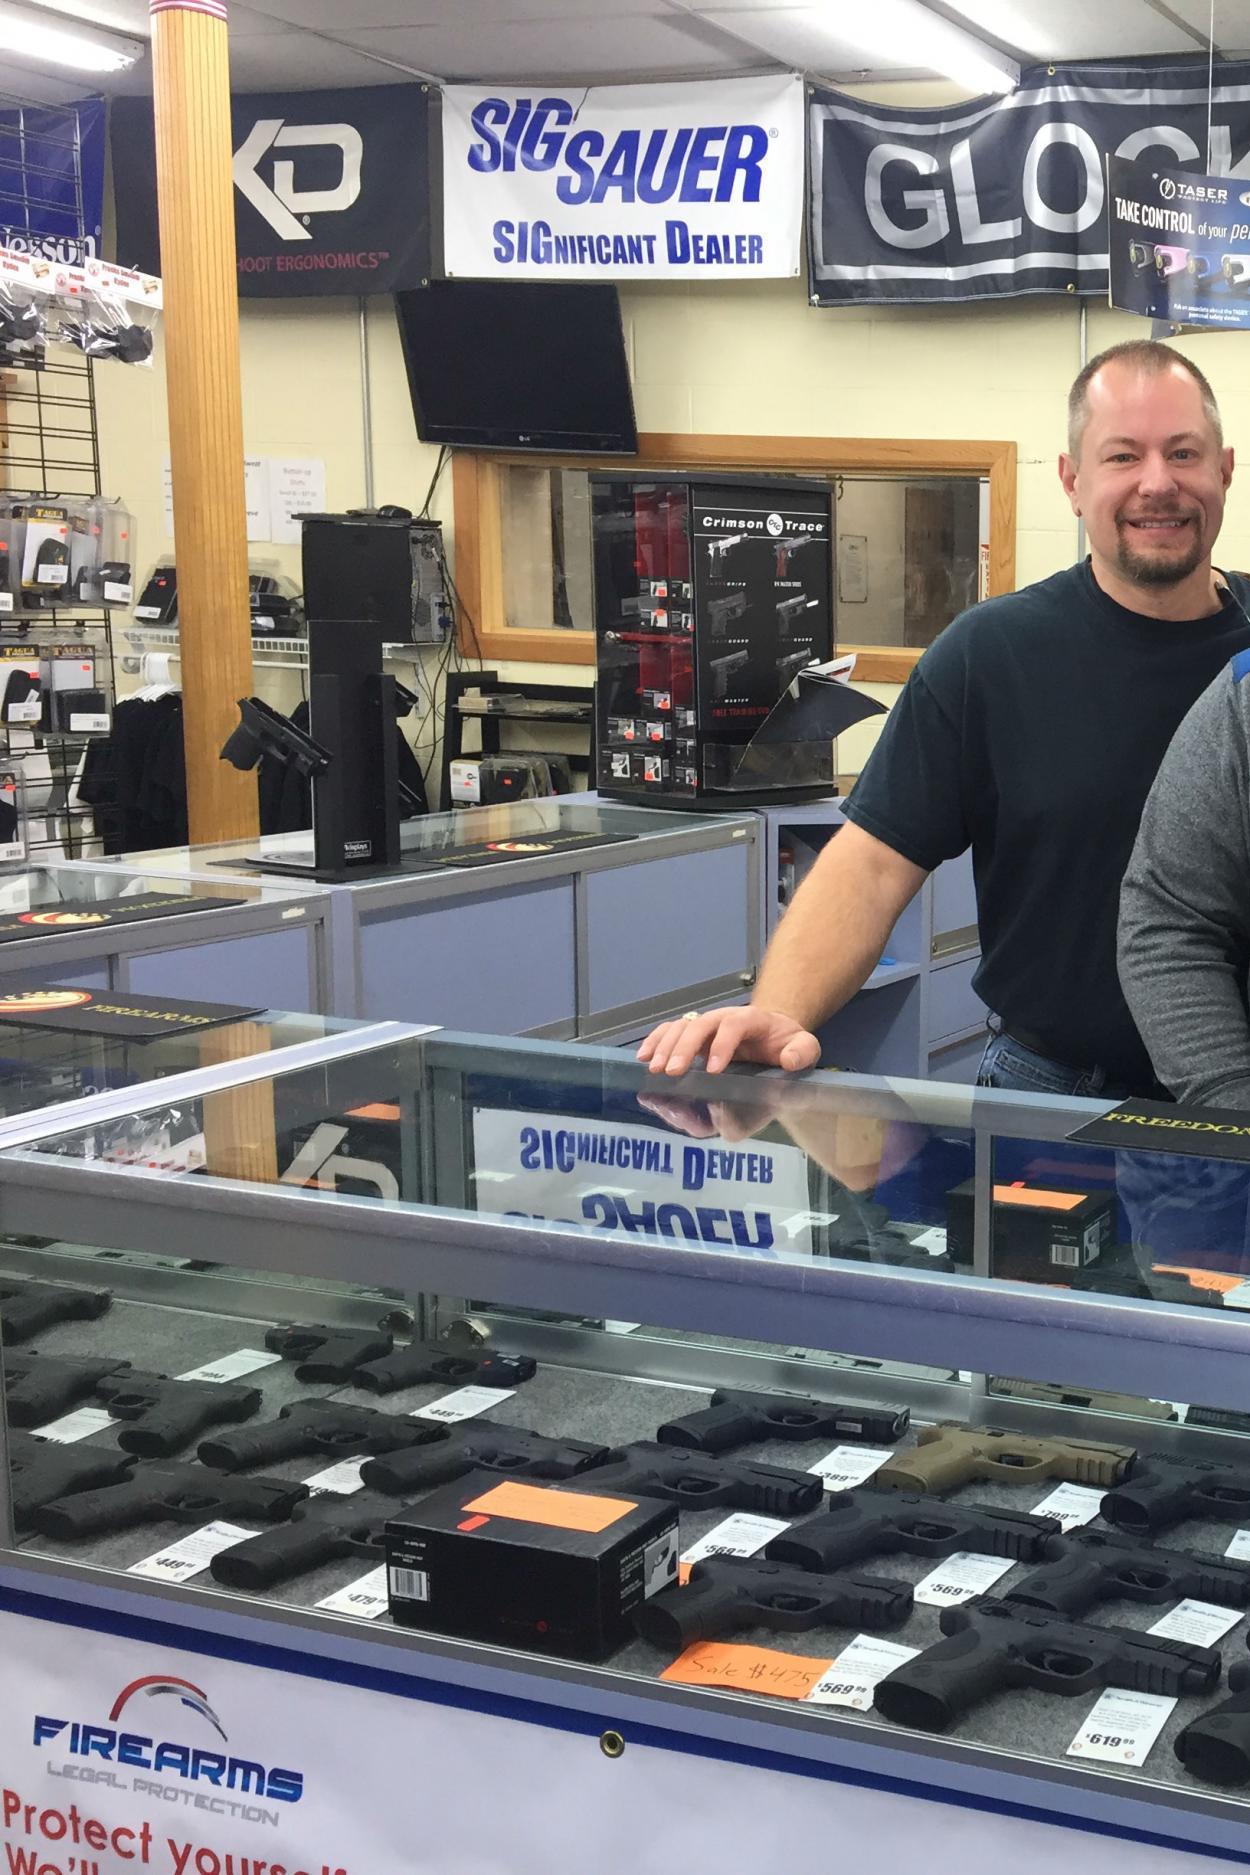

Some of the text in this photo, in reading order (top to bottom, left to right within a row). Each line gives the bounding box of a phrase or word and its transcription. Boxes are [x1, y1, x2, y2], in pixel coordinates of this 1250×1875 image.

[467, 97, 577, 174] SIG
[1177, 183, 1227, 200] TASER
[1115, 197, 1140, 224] TAKE
[1141, 202, 1195, 234] CONTROL
[1198, 223, 1207, 235] of
[1208, 226, 1227, 238] your
[493, 218, 764, 266] SIGNIFICANT DEALER
[702, 516, 824, 532] Crimson Trace
[691, 1656, 811, 1687] Sale $475
[33, 1715, 304, 1803] FIREARMS
[46, 1760, 280, 1827] LEGAL PROTECTION
[2, 1788, 348, 1875] Protect your
